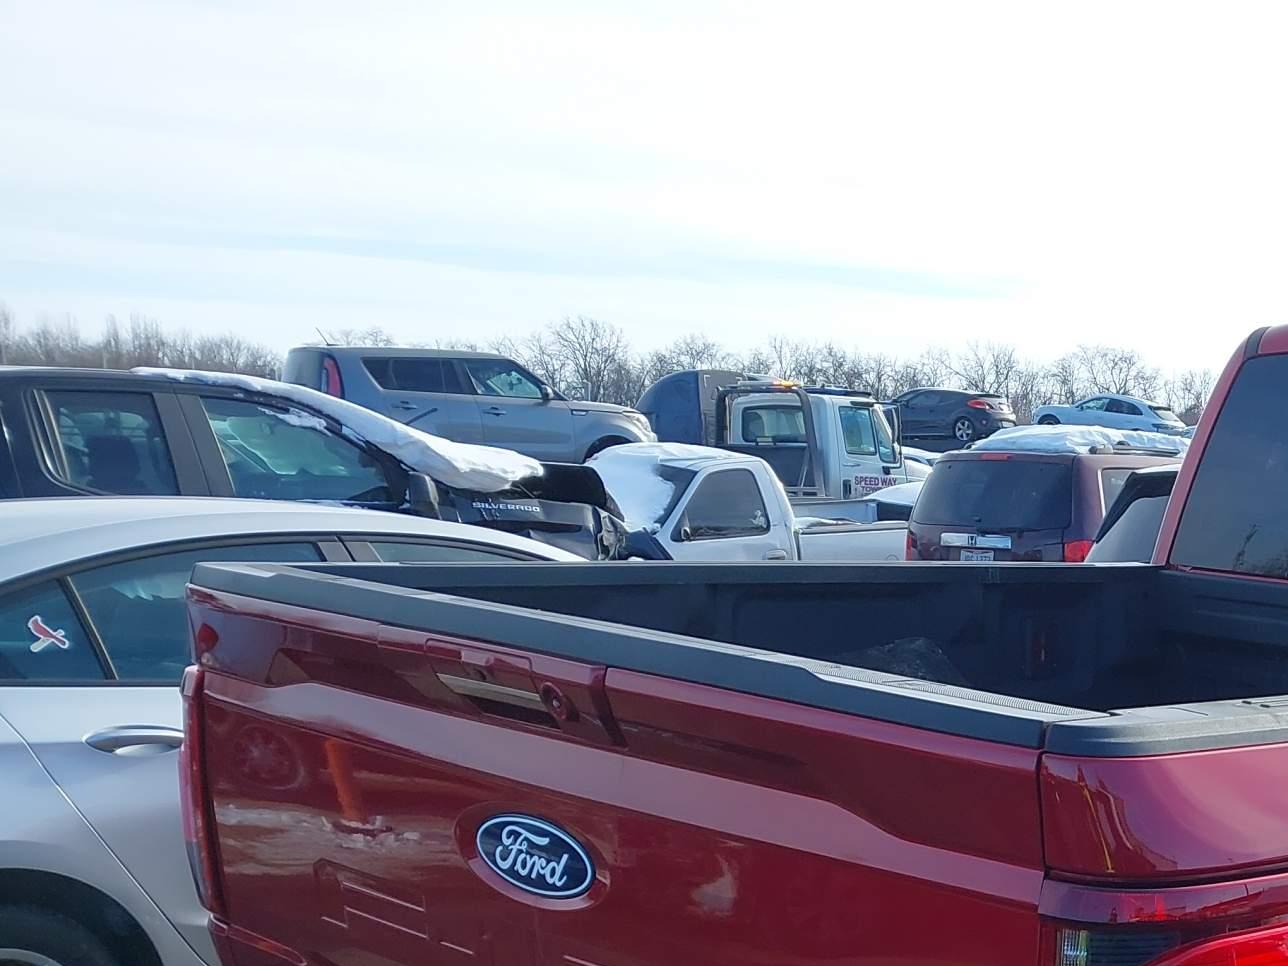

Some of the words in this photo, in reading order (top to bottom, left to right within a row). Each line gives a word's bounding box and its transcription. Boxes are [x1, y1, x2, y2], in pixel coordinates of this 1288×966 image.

[854, 475, 880, 486] SPEED
[881, 476, 897, 486] WAY
[472, 501, 541, 512] SILVERADO
[495, 825, 569, 887] Ford
